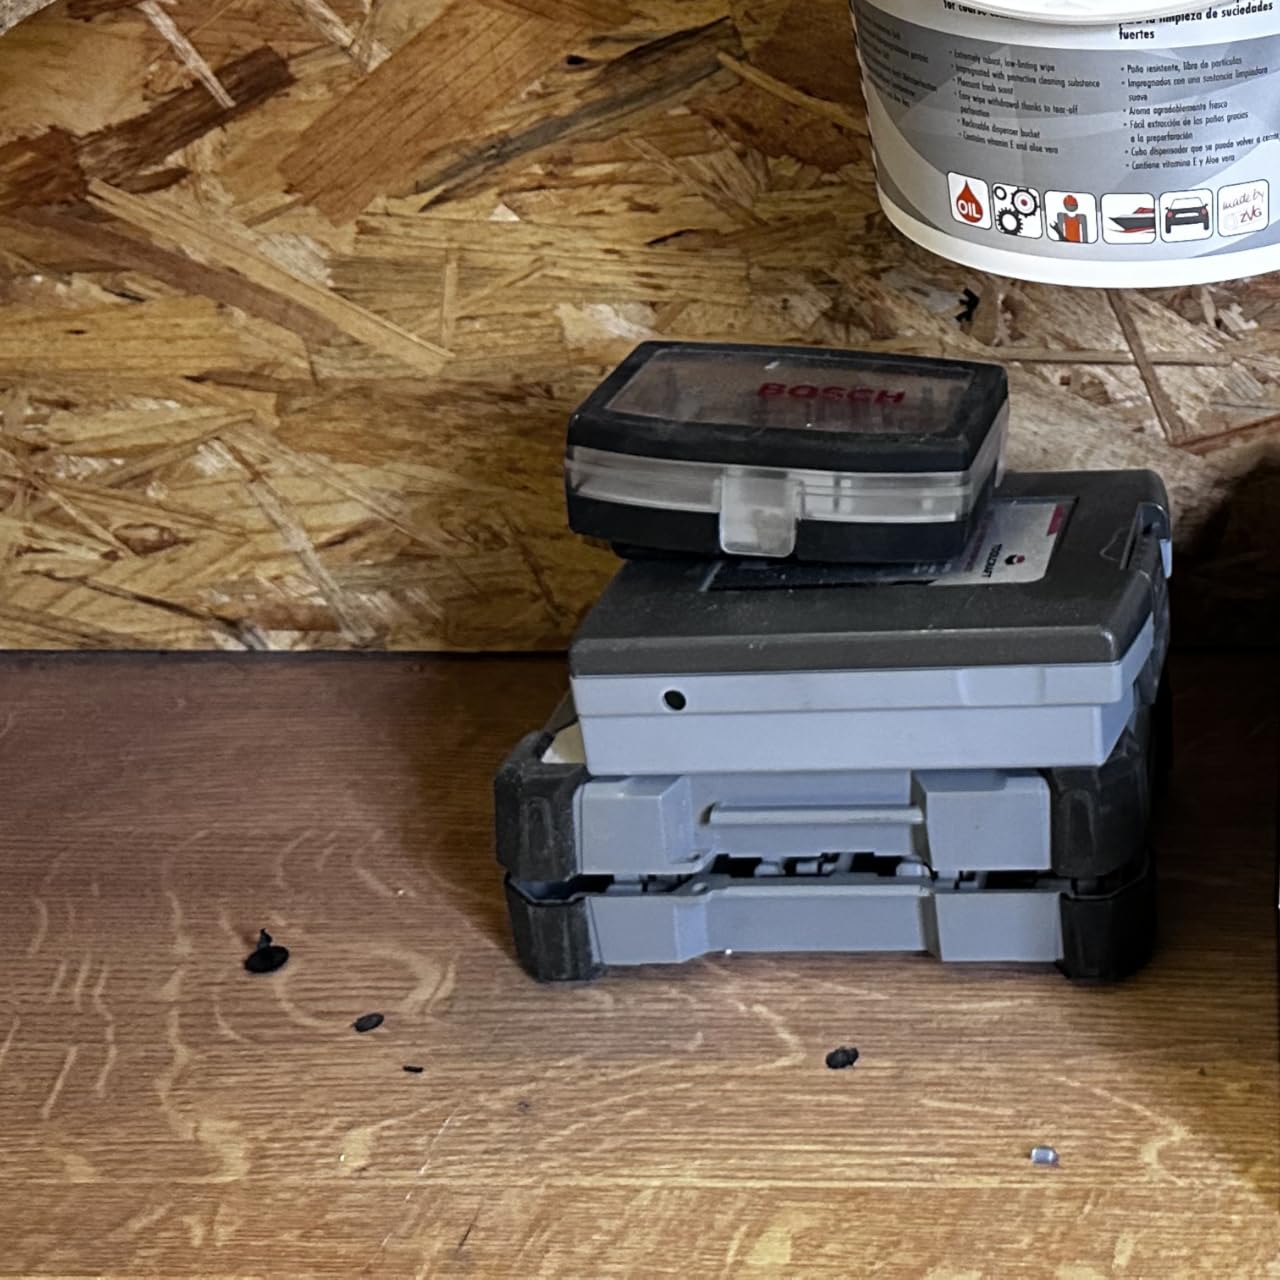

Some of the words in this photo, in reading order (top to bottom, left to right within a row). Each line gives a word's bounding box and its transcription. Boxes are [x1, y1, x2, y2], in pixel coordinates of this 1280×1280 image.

[1206, 7, 1218, 20] de
[1222, 0, 1273, 17] suciedades
[1068, 78, 1100, 88] substance
[1205, 156, 1219, 165] Aloe
[958, 199, 980, 217] OIL
[758, 382, 905, 405] BOSCH
